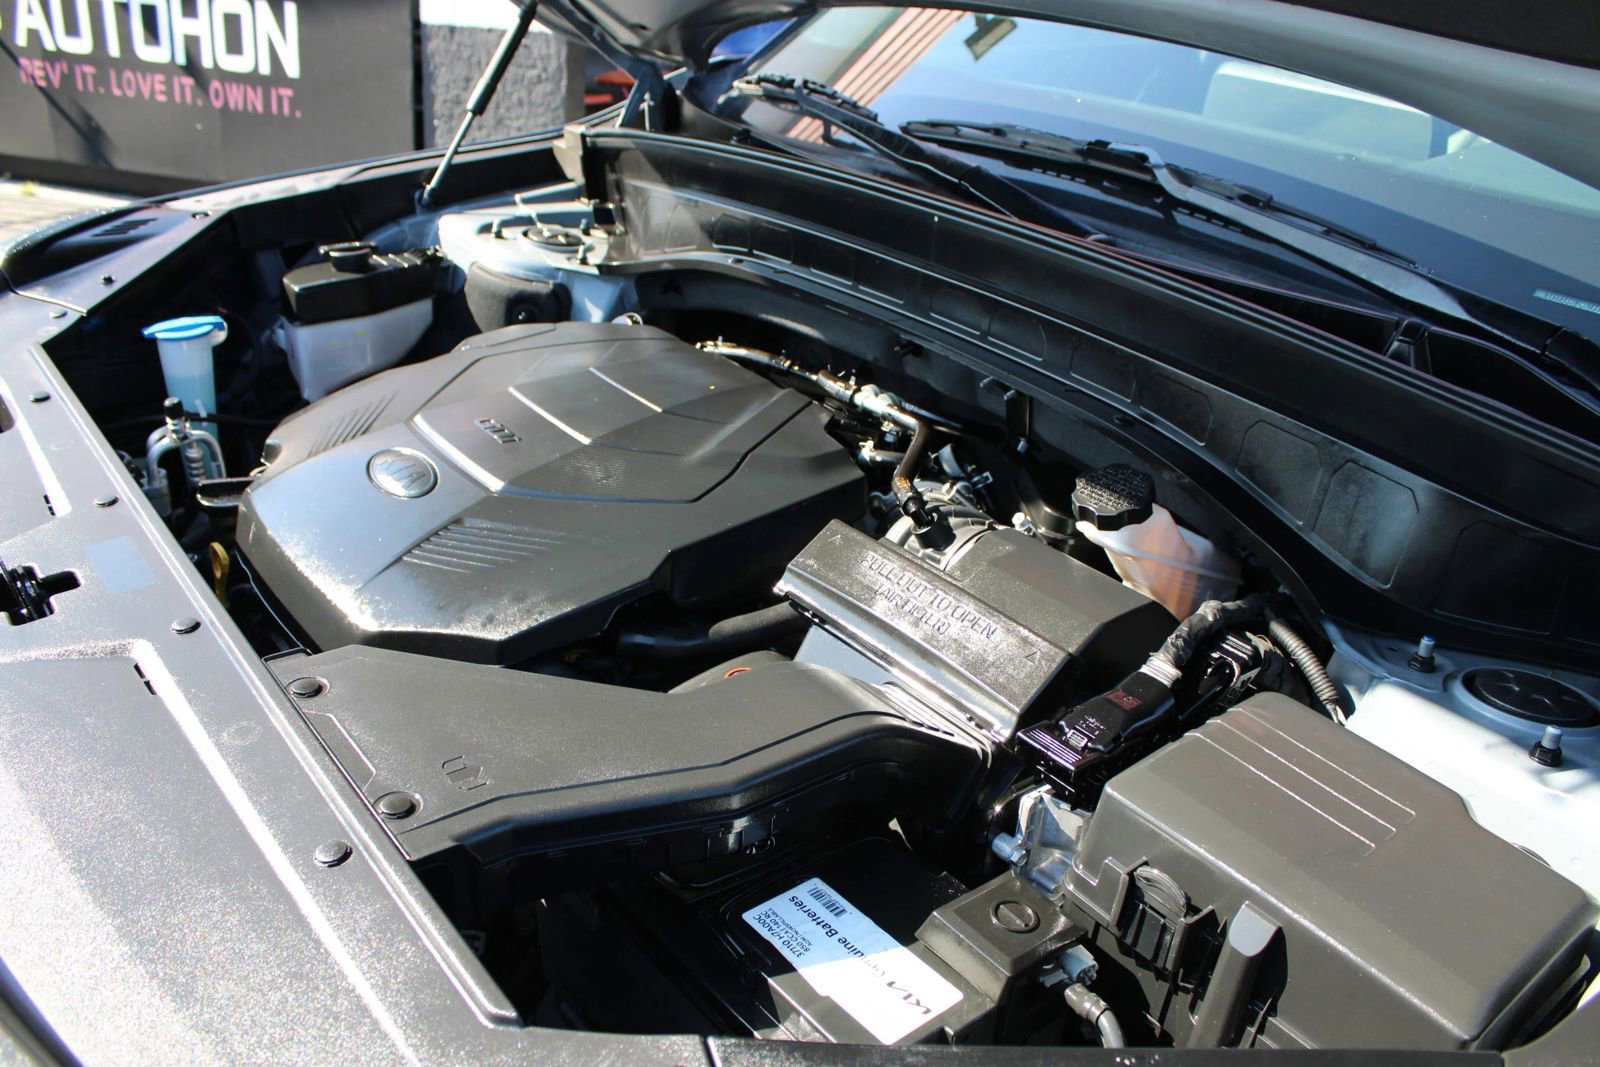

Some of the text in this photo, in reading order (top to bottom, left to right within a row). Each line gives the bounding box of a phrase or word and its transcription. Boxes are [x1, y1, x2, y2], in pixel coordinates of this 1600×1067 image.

[74, 63, 105, 94] IT.
[110, 68, 167, 103] LOVE
[172, 76, 204, 107] IT.
[209, 85, 264, 115] OWN
[270, 88, 302, 119] IT.
[860, 551, 998, 640] PULL OUT TO OPEN
[760, 910, 772, 919] RC
[769, 918, 782, 928] 140
[788, 895, 838, 938] Batteries
[784, 930, 798, 942] CCA
[782, 939, 806, 959] 37110
[796, 941, 810, 952] 850
[886, 981, 932, 1015] KIA
